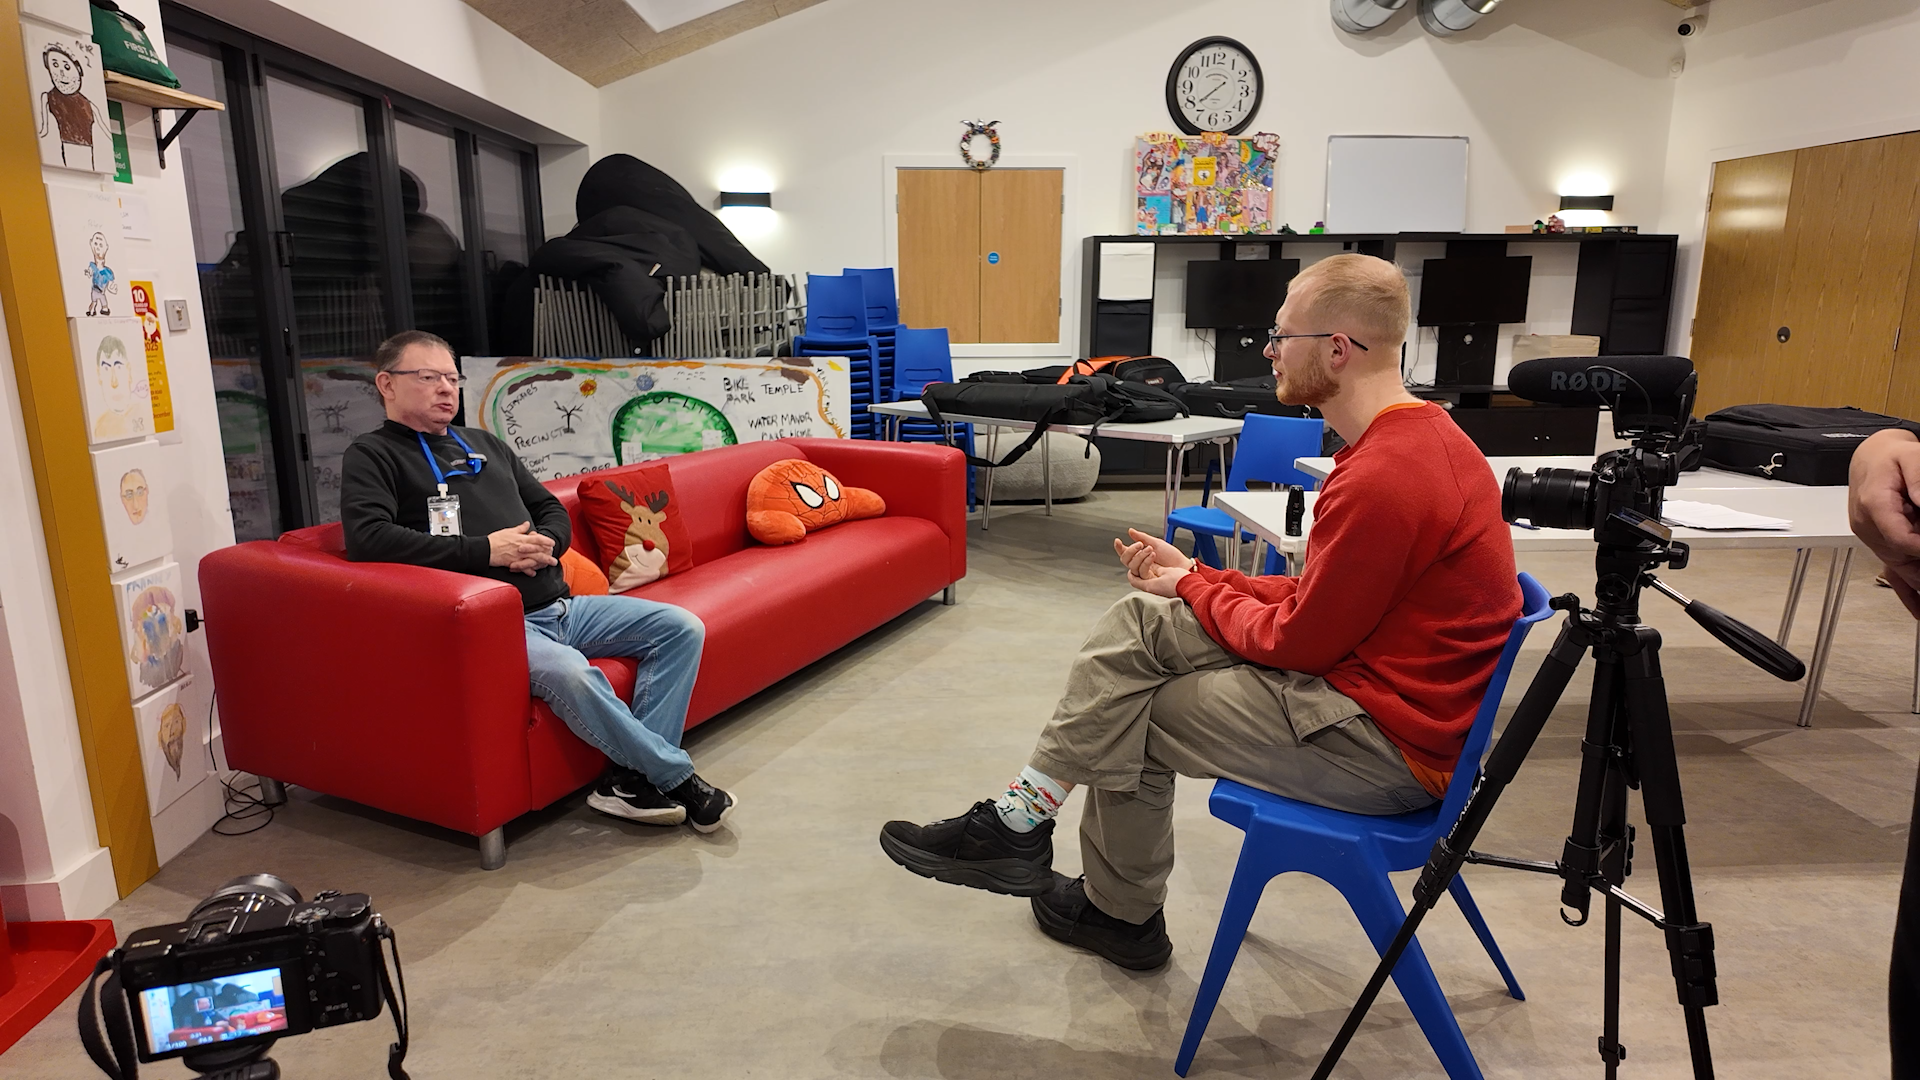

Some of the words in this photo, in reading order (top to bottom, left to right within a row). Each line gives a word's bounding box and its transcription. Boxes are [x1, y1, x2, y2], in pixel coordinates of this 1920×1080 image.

[123, 40, 148, 56] FIRST
[1201, 55, 1210, 68] 11
[1213, 52, 1226, 65] 12
[1231, 58, 1236, 71] 1
[1188, 66, 1200, 79] 10
[1237, 70, 1247, 83] 2
[1182, 80, 1194, 95] 9
[1240, 84, 1250, 98] 3
[1184, 95, 1196, 110] 8
[1232, 99, 1243, 112] 4
[1195, 109, 1205, 122] 7
[1207, 112, 1218, 127] 6
[1222, 110, 1232, 124] 5
[132, 289, 146, 303] 10
[723, 377, 749, 392] BIKE
[761, 383, 804, 395] TEMPLE
[748, 414, 778, 429] WATER
[514, 426, 564, 450] PRECINCT
